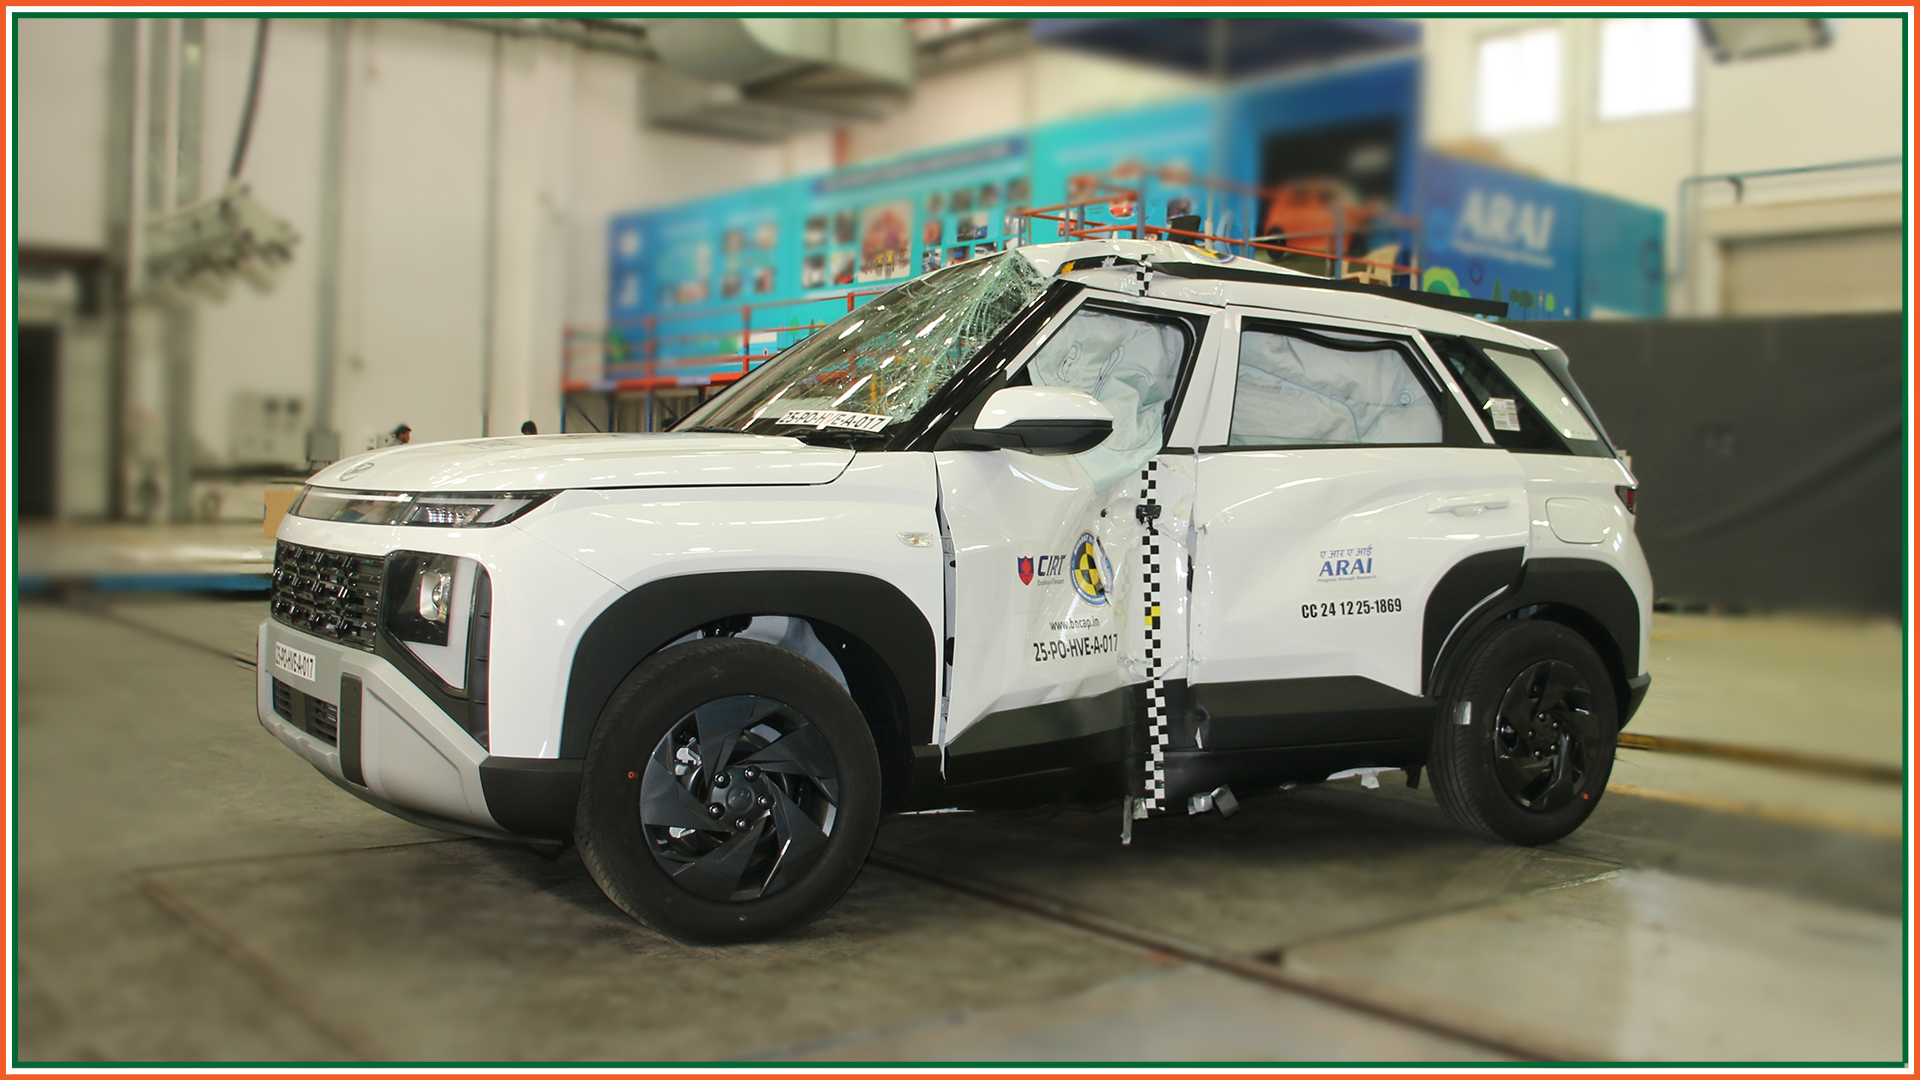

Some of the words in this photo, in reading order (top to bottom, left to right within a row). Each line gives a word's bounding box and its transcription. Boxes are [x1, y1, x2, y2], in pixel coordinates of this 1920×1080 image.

[1037, 554, 1066, 576] CIRT
[1318, 557, 1373, 577] ARAI
[1301, 604, 1318, 618] CC
[1320, 602, 1337, 617] 24
[1049, 616, 1100, 630] www.bncap.in
[1033, 633, 1118, 662] 25-PO-HVE-A-017
